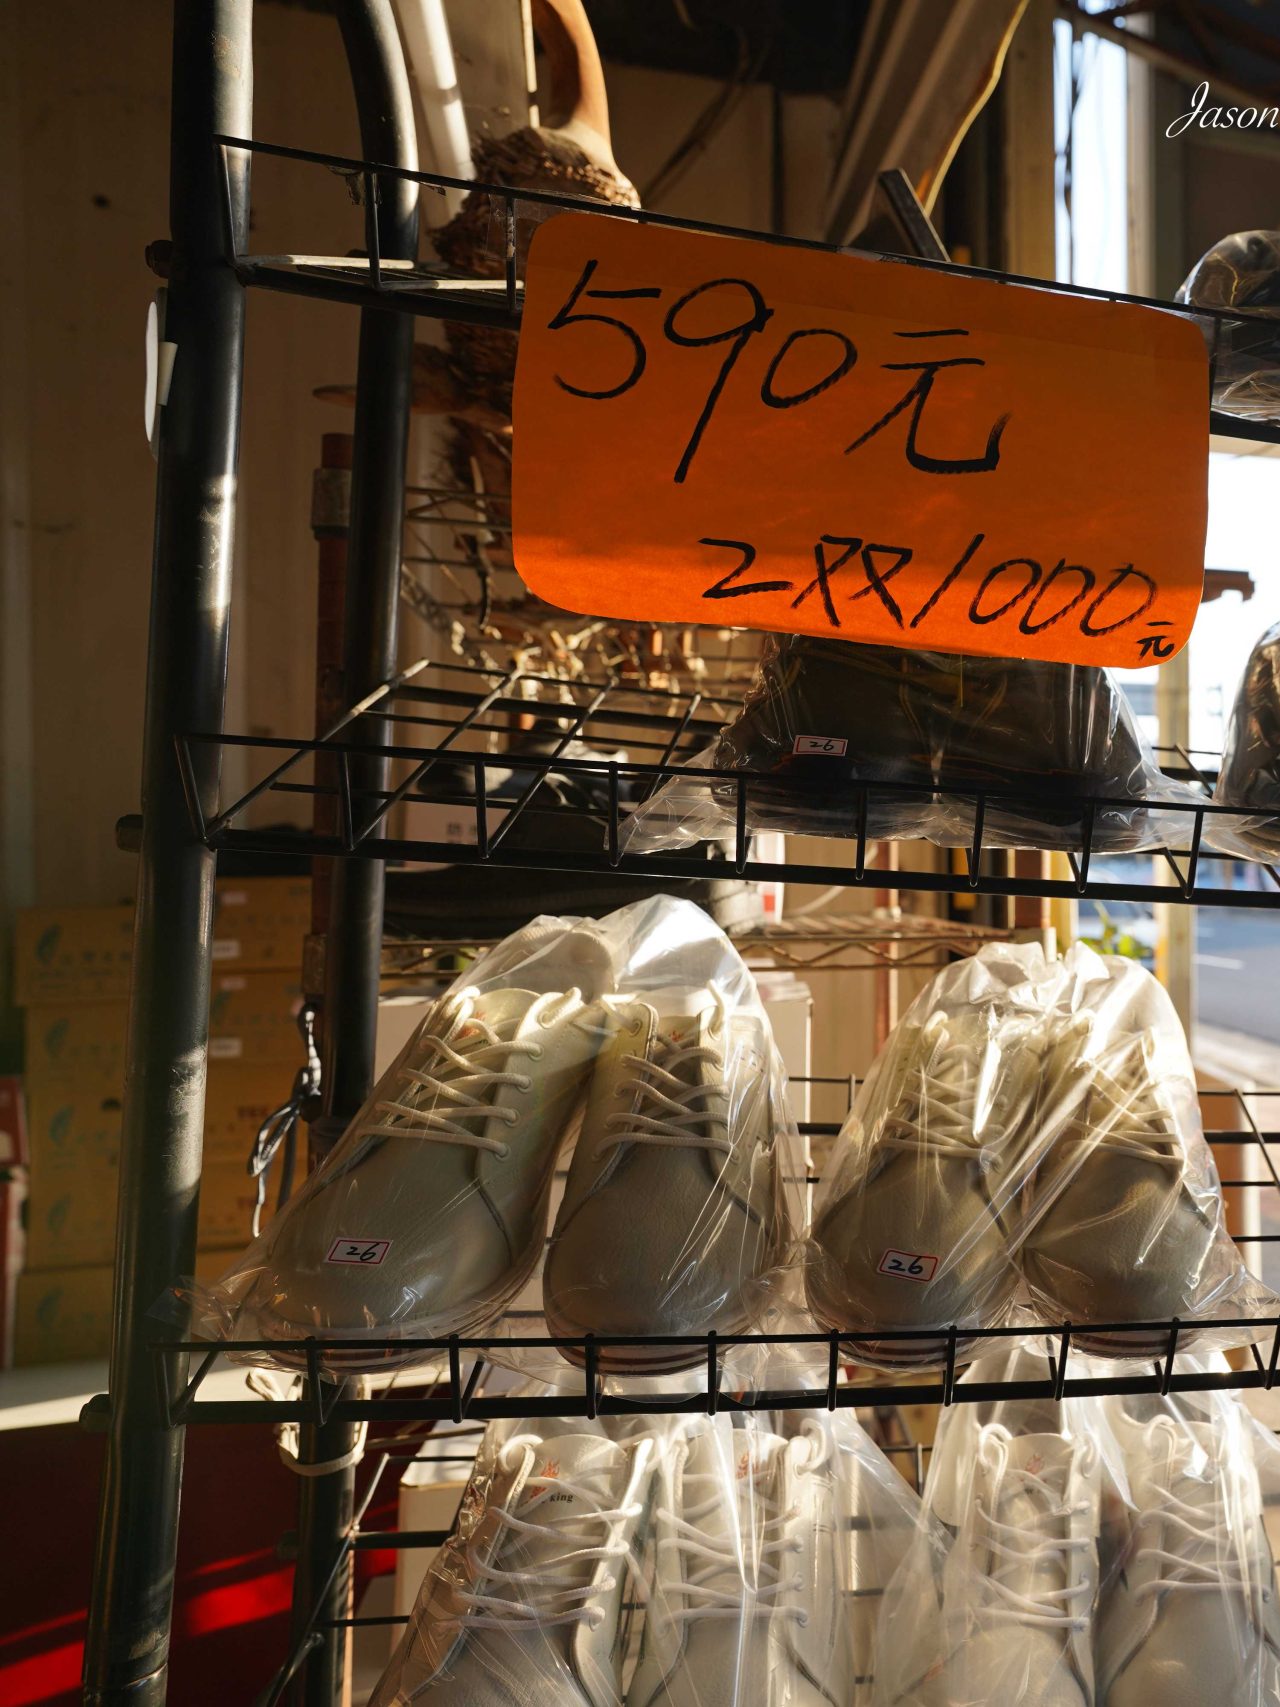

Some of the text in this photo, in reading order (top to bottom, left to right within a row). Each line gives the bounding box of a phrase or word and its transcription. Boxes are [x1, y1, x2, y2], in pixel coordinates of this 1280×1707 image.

[547, 259, 1011, 484] 590元
[809, 739, 834, 751] 26
[346, 1242, 378, 1261] 26
[887, 1255, 924, 1275] 26
